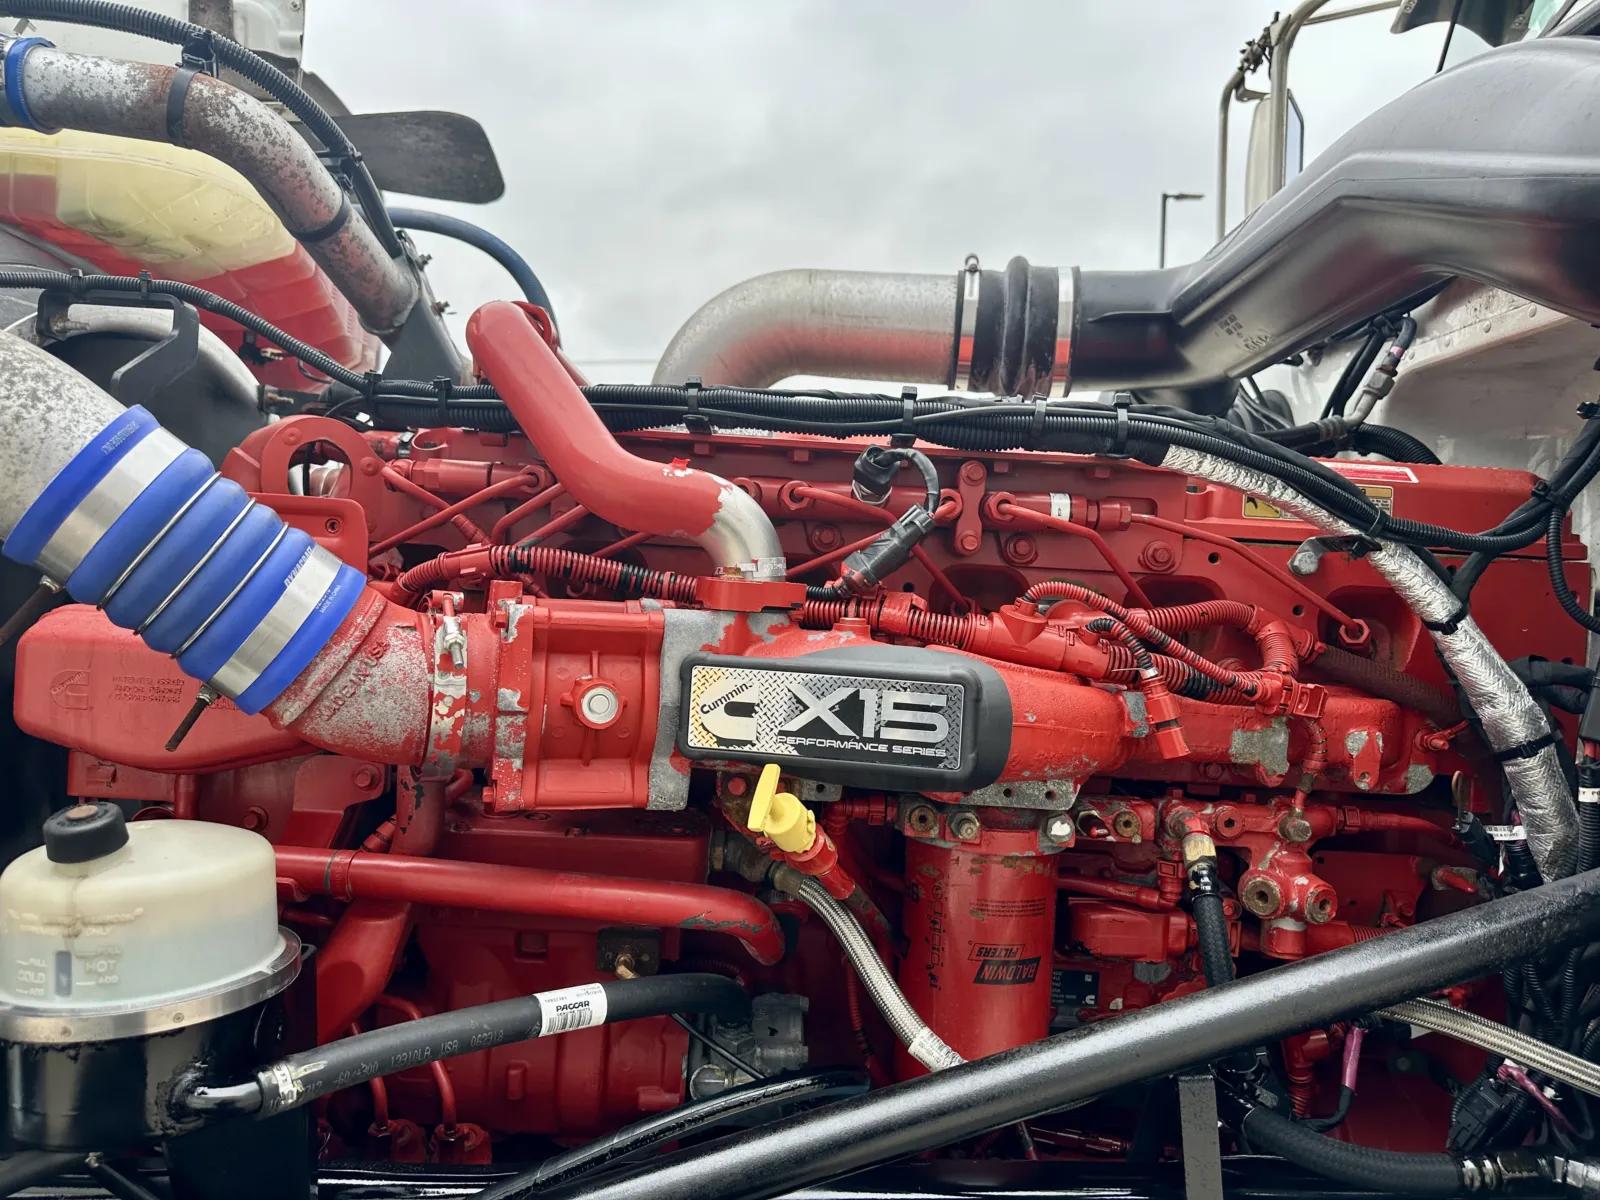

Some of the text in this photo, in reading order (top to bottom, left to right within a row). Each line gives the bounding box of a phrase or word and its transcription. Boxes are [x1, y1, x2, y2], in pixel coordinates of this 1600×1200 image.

[777, 734, 947, 758] PERFORMANCE SERIES
[976, 946, 1020, 959] FILTERS
[85, 959, 118, 974] HOT
[981, 962, 1037, 982] BALDWIN
[556, 1000, 590, 1013] PACCAR
